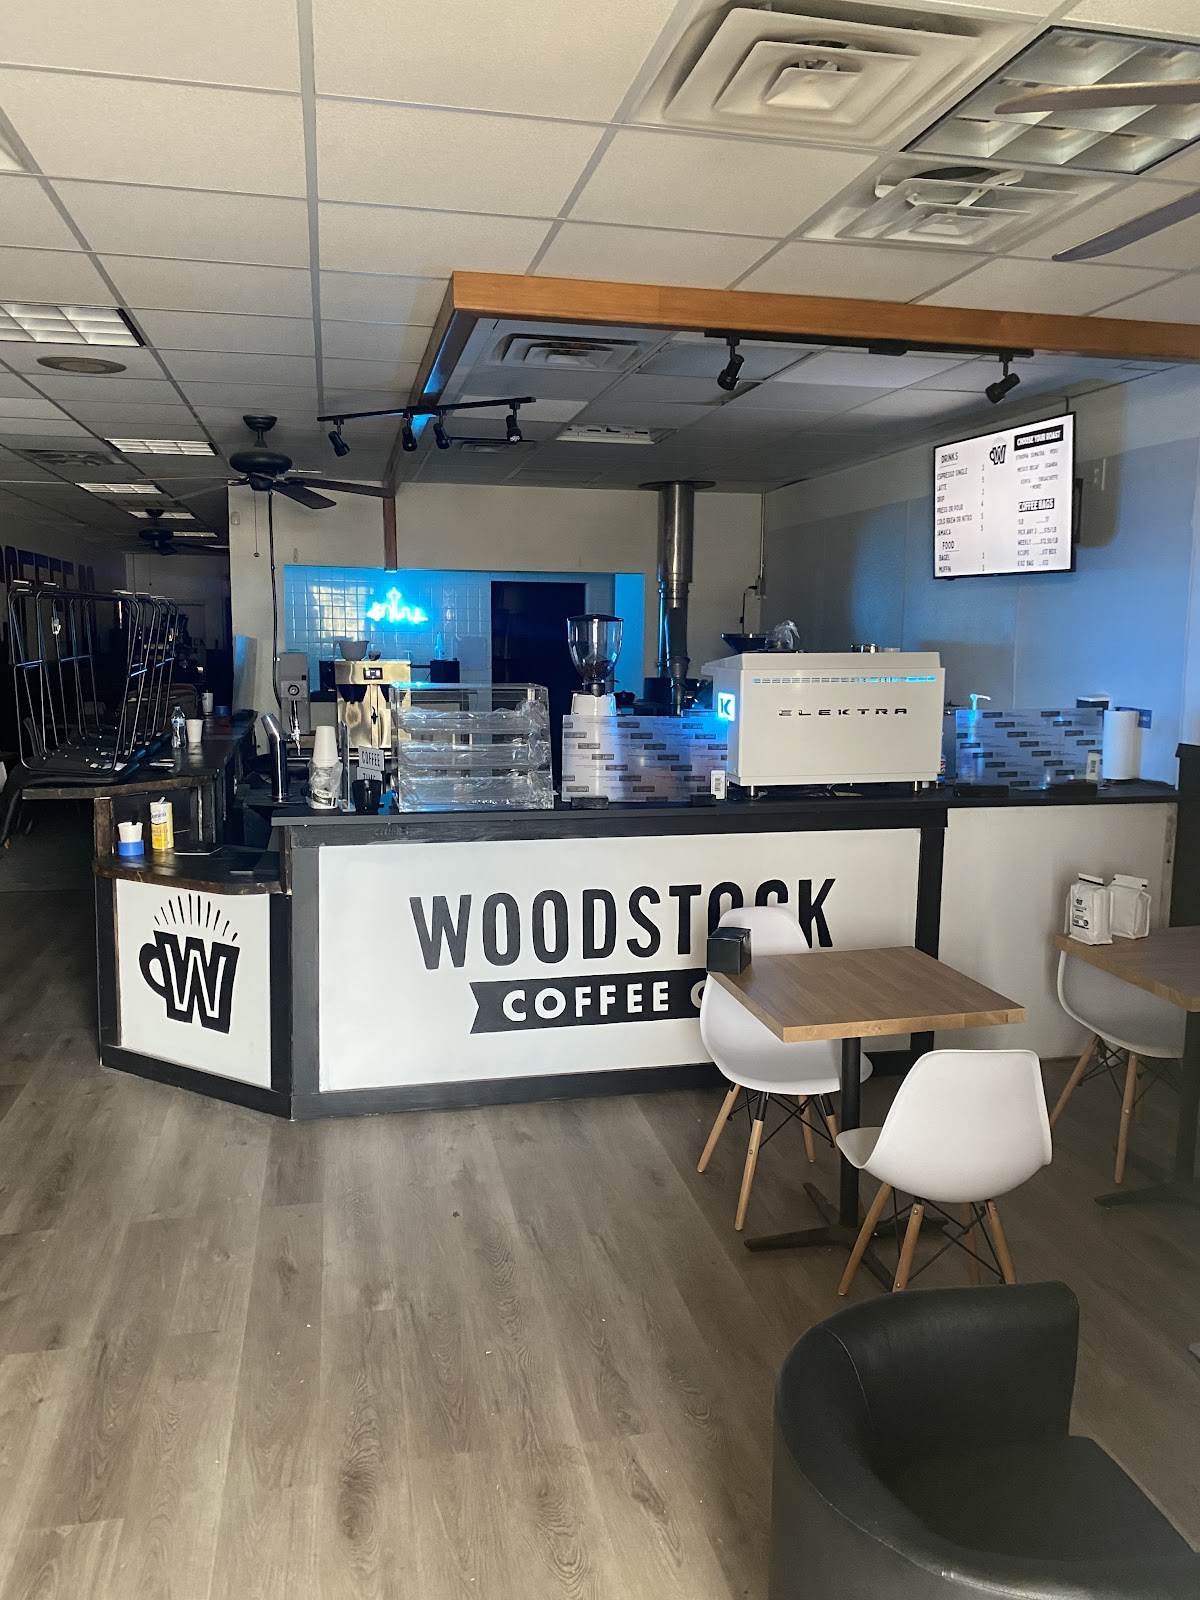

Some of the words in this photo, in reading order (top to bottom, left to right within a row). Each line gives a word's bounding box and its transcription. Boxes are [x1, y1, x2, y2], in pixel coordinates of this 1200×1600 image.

[941, 451, 959, 464] DRINKS
[1019, 501, 1038, 511] COFFEE
[1038, 499, 1053, 509] BAGS
[942, 540, 954, 550] FOOD
[779, 708, 908, 717] ELEKTRA
[361, 751, 380, 767] COFFEE
[502, 980, 669, 1023] COFFEE
